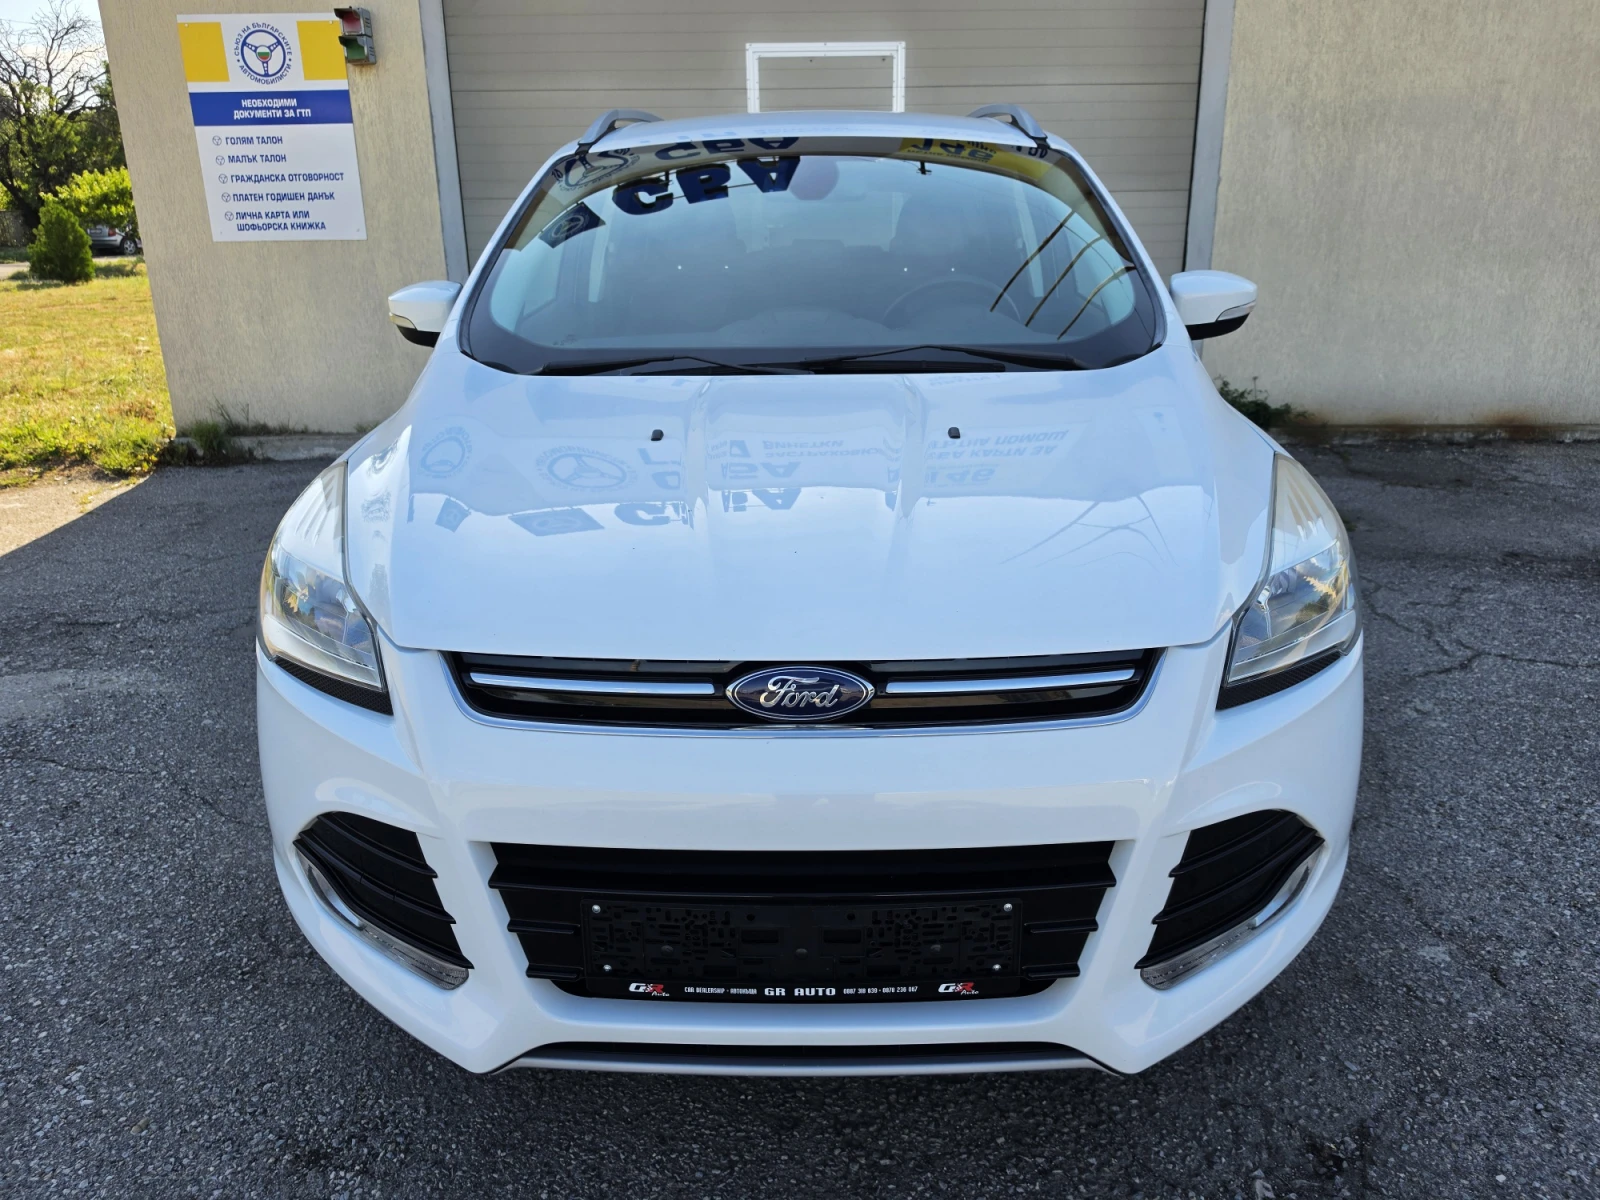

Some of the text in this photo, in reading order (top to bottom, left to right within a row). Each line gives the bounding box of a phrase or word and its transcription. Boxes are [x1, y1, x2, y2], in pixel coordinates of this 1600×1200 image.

[241, 25, 252, 35] НА
[251, 22, 292, 56] БЪЛГАРСКИТЕ
[238, 63, 292, 85] АВТОМОБИЛИСТИ
[241, 98, 297, 108] НЕОБХОДИМИ
[233, 108, 312, 120] ДОКУМЕНТИ ЗА ГТП
[225, 136, 283, 145] ГОЛЯМ ТАЛОН
[227, 154, 287, 164] МАЛЪК ТАЛОН
[230, 172, 344, 184] ГРАЖДАНСКА ОТГОВОРНОСТ
[233, 192, 335, 203] ПЛАТЕН ГОДИШЕН ДАНЪК
[235, 210, 310, 221] ЛИЧНА КАРТА ИЛИ
[237, 222, 326, 232] ШОФЬОРСКА КНИЖКА
[760, 675, 840, 708] Ford
[764, 987, 836, 996] GR AUTO
